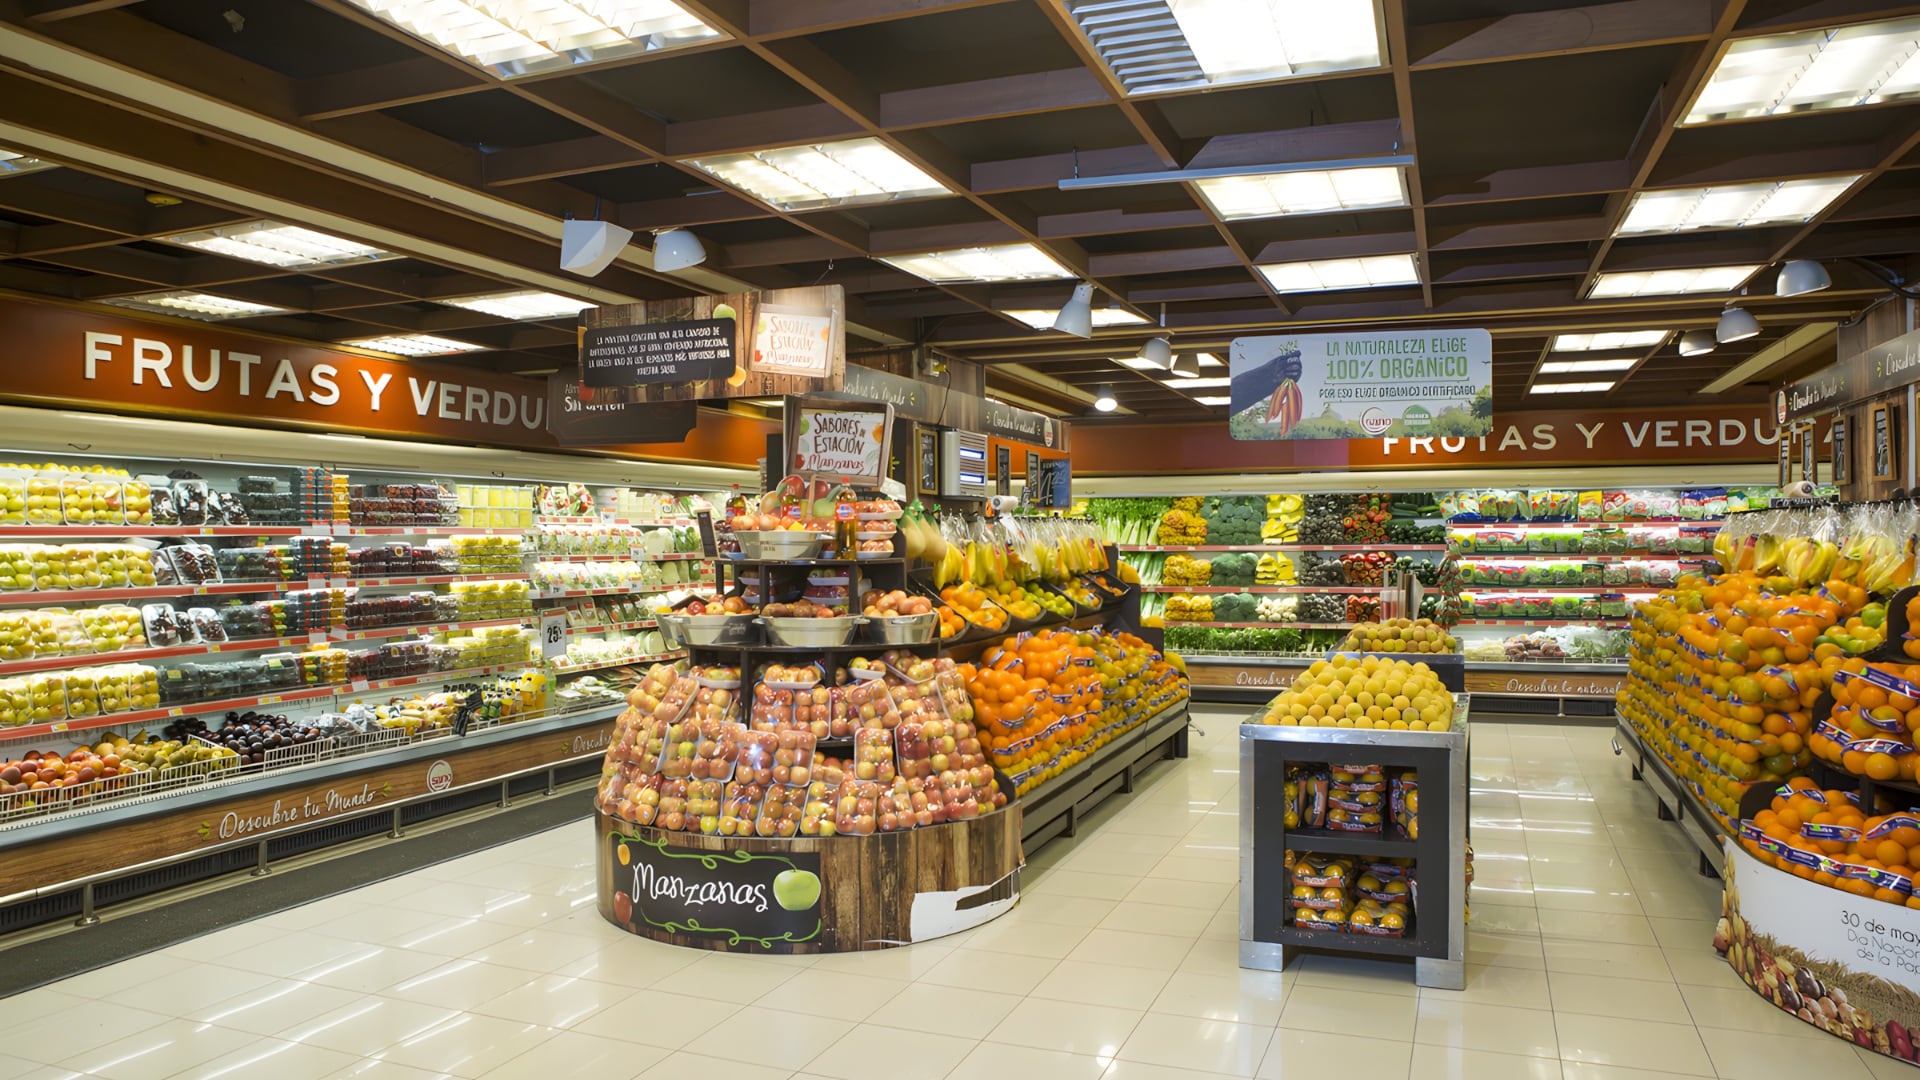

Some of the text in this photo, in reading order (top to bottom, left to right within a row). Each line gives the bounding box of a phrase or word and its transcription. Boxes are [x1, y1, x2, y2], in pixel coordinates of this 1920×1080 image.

[1326, 341, 1340, 357] LA
[1345, 338, 1426, 357] NATURALEZA
[1326, 358, 1374, 380] 100%
[84, 331, 549, 431] FRUTAS Y VERDU
[814, 413, 860, 435] SABORES
[814, 434, 864, 456] ESTACIÓN
[1383, 425, 1557, 455] FRUTAS
[1575, 422, 1605, 449] Y
[1506, 678, 1558, 694] Descubre
[218, 784, 376, 840] Descubre tu Mundo
[632, 862, 769, 913] Manzanas
[1841, 910, 1860, 928] 30
[1864, 919, 1886, 935] de
[1857, 947, 1875, 962] de
[1877, 951, 1890, 966] la
